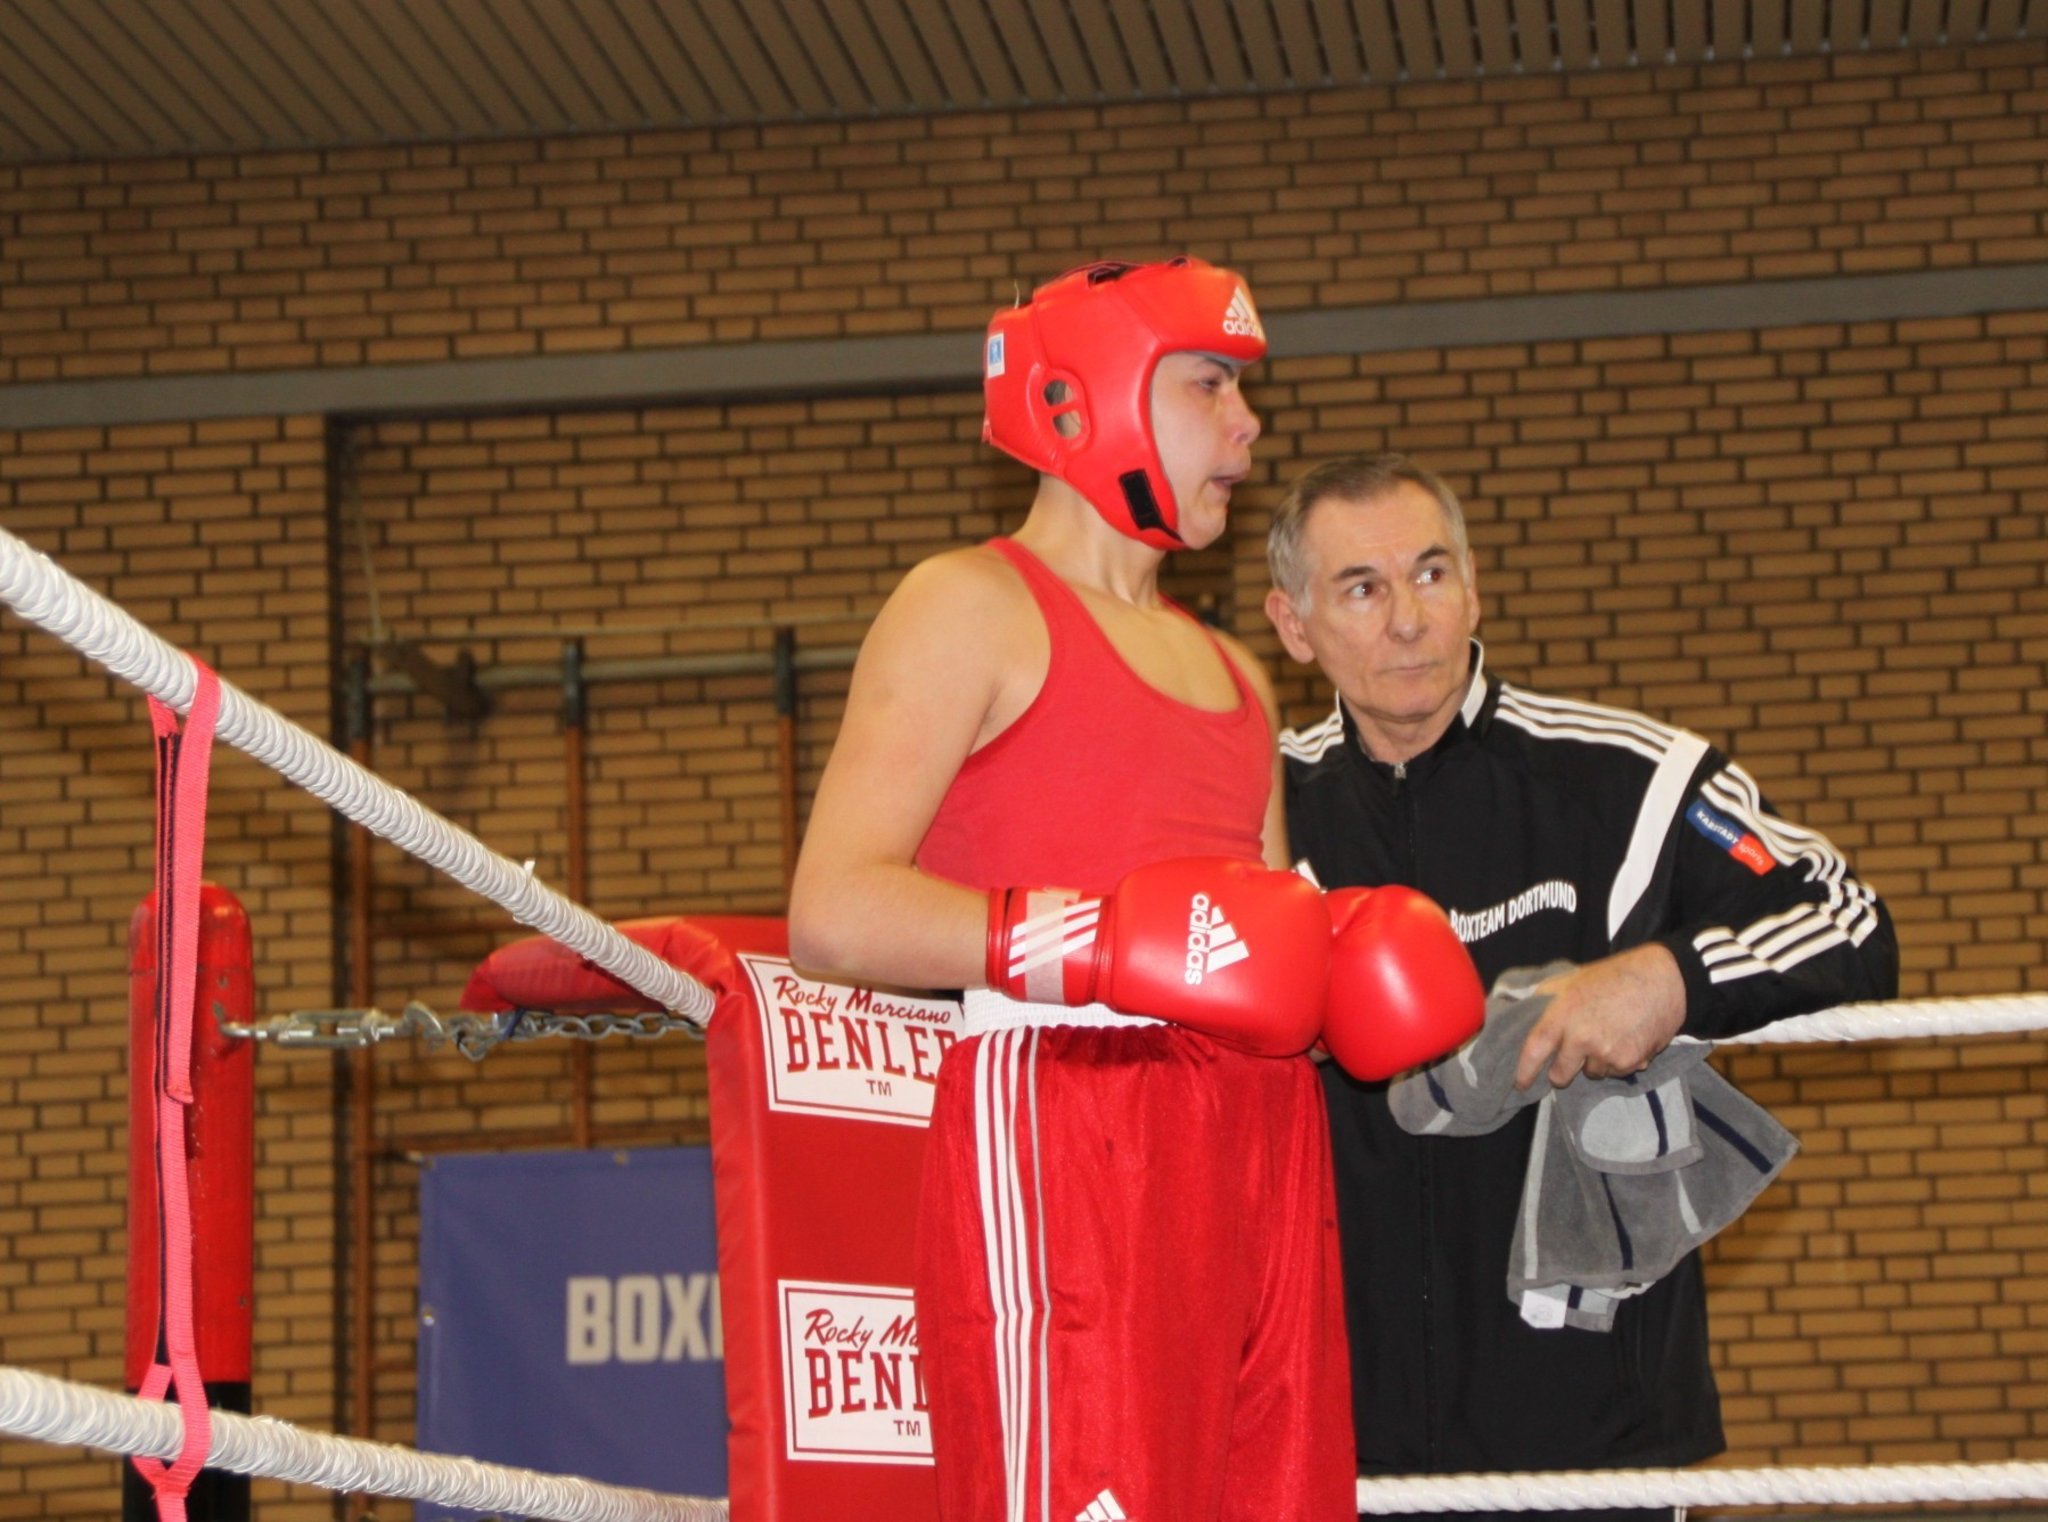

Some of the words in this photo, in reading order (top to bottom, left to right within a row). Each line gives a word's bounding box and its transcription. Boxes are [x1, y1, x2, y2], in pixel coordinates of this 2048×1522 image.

[1450, 903, 1505, 942] BOXTEAM
[1508, 881, 1577, 925] DORTMUND
[1185, 893, 1213, 985] adidas
[773, 975, 837, 1017] Rocky
[845, 984, 951, 1025] Marciano
[866, 1079, 892, 1097] TM
[804, 1308, 873, 1352] Rocky
[894, 1420, 921, 1436] TM
